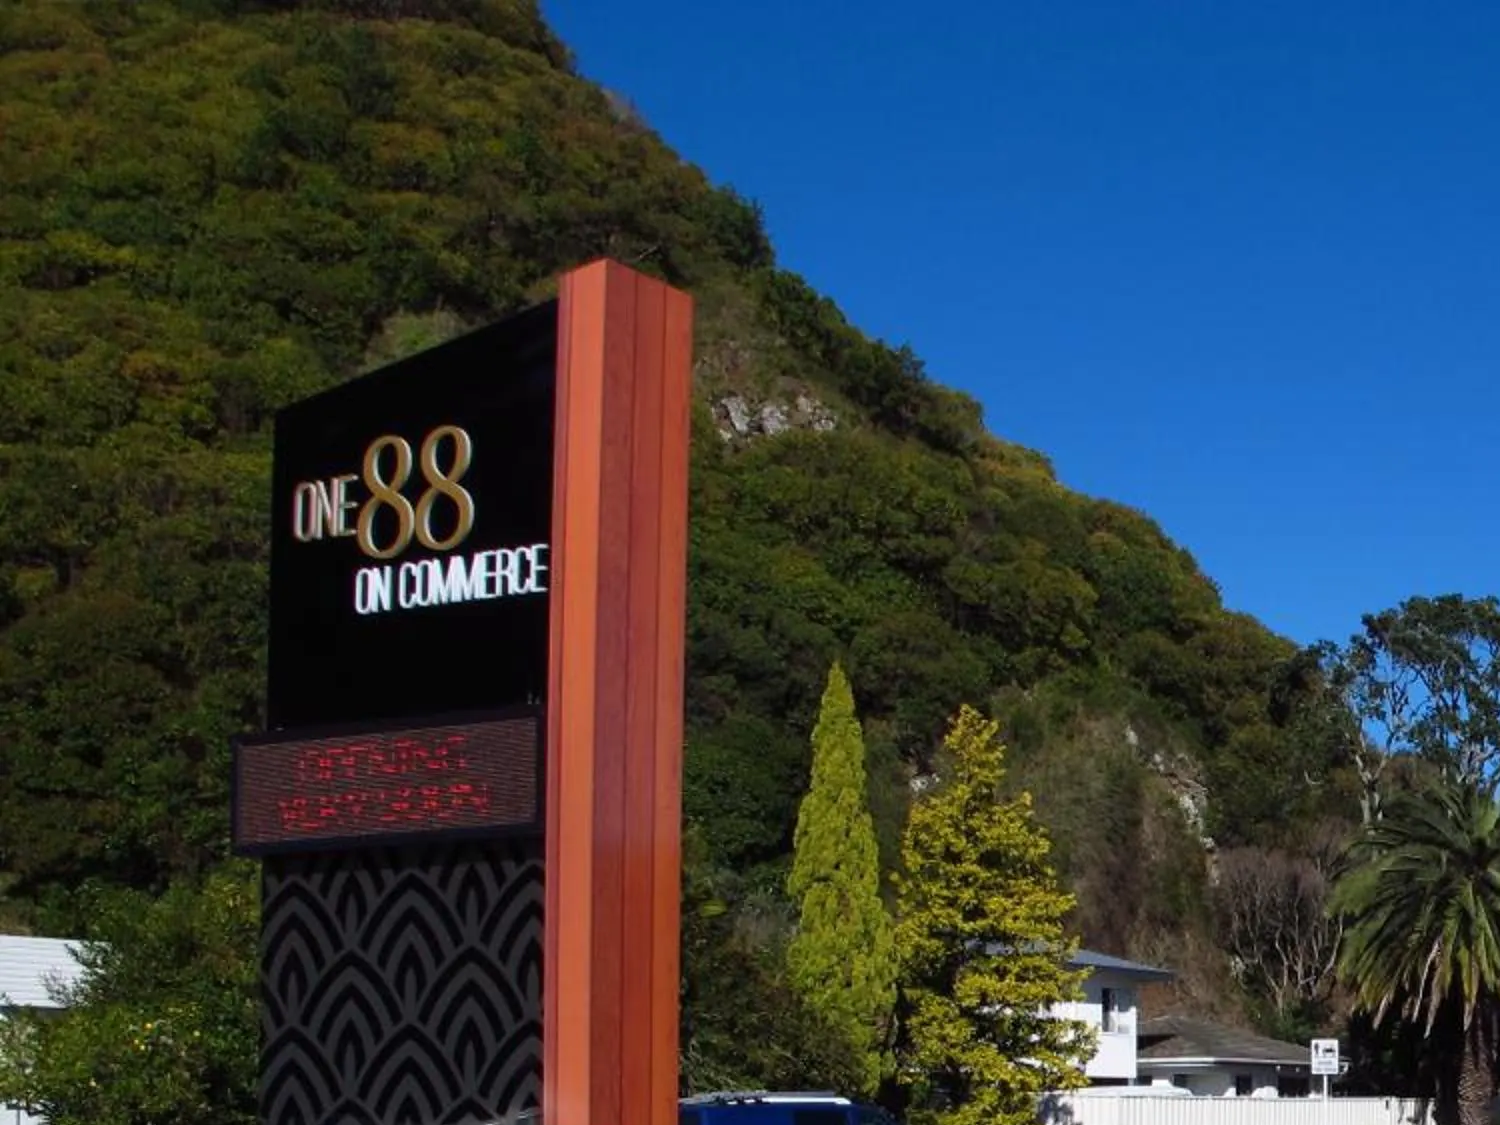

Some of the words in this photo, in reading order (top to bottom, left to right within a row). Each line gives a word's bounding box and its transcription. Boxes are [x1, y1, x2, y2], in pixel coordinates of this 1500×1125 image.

[294, 474, 358, 541] ONE
[357, 425, 475, 559] 88
[355, 565, 392, 614] ON
[400, 544, 549, 609] COMMERCE
